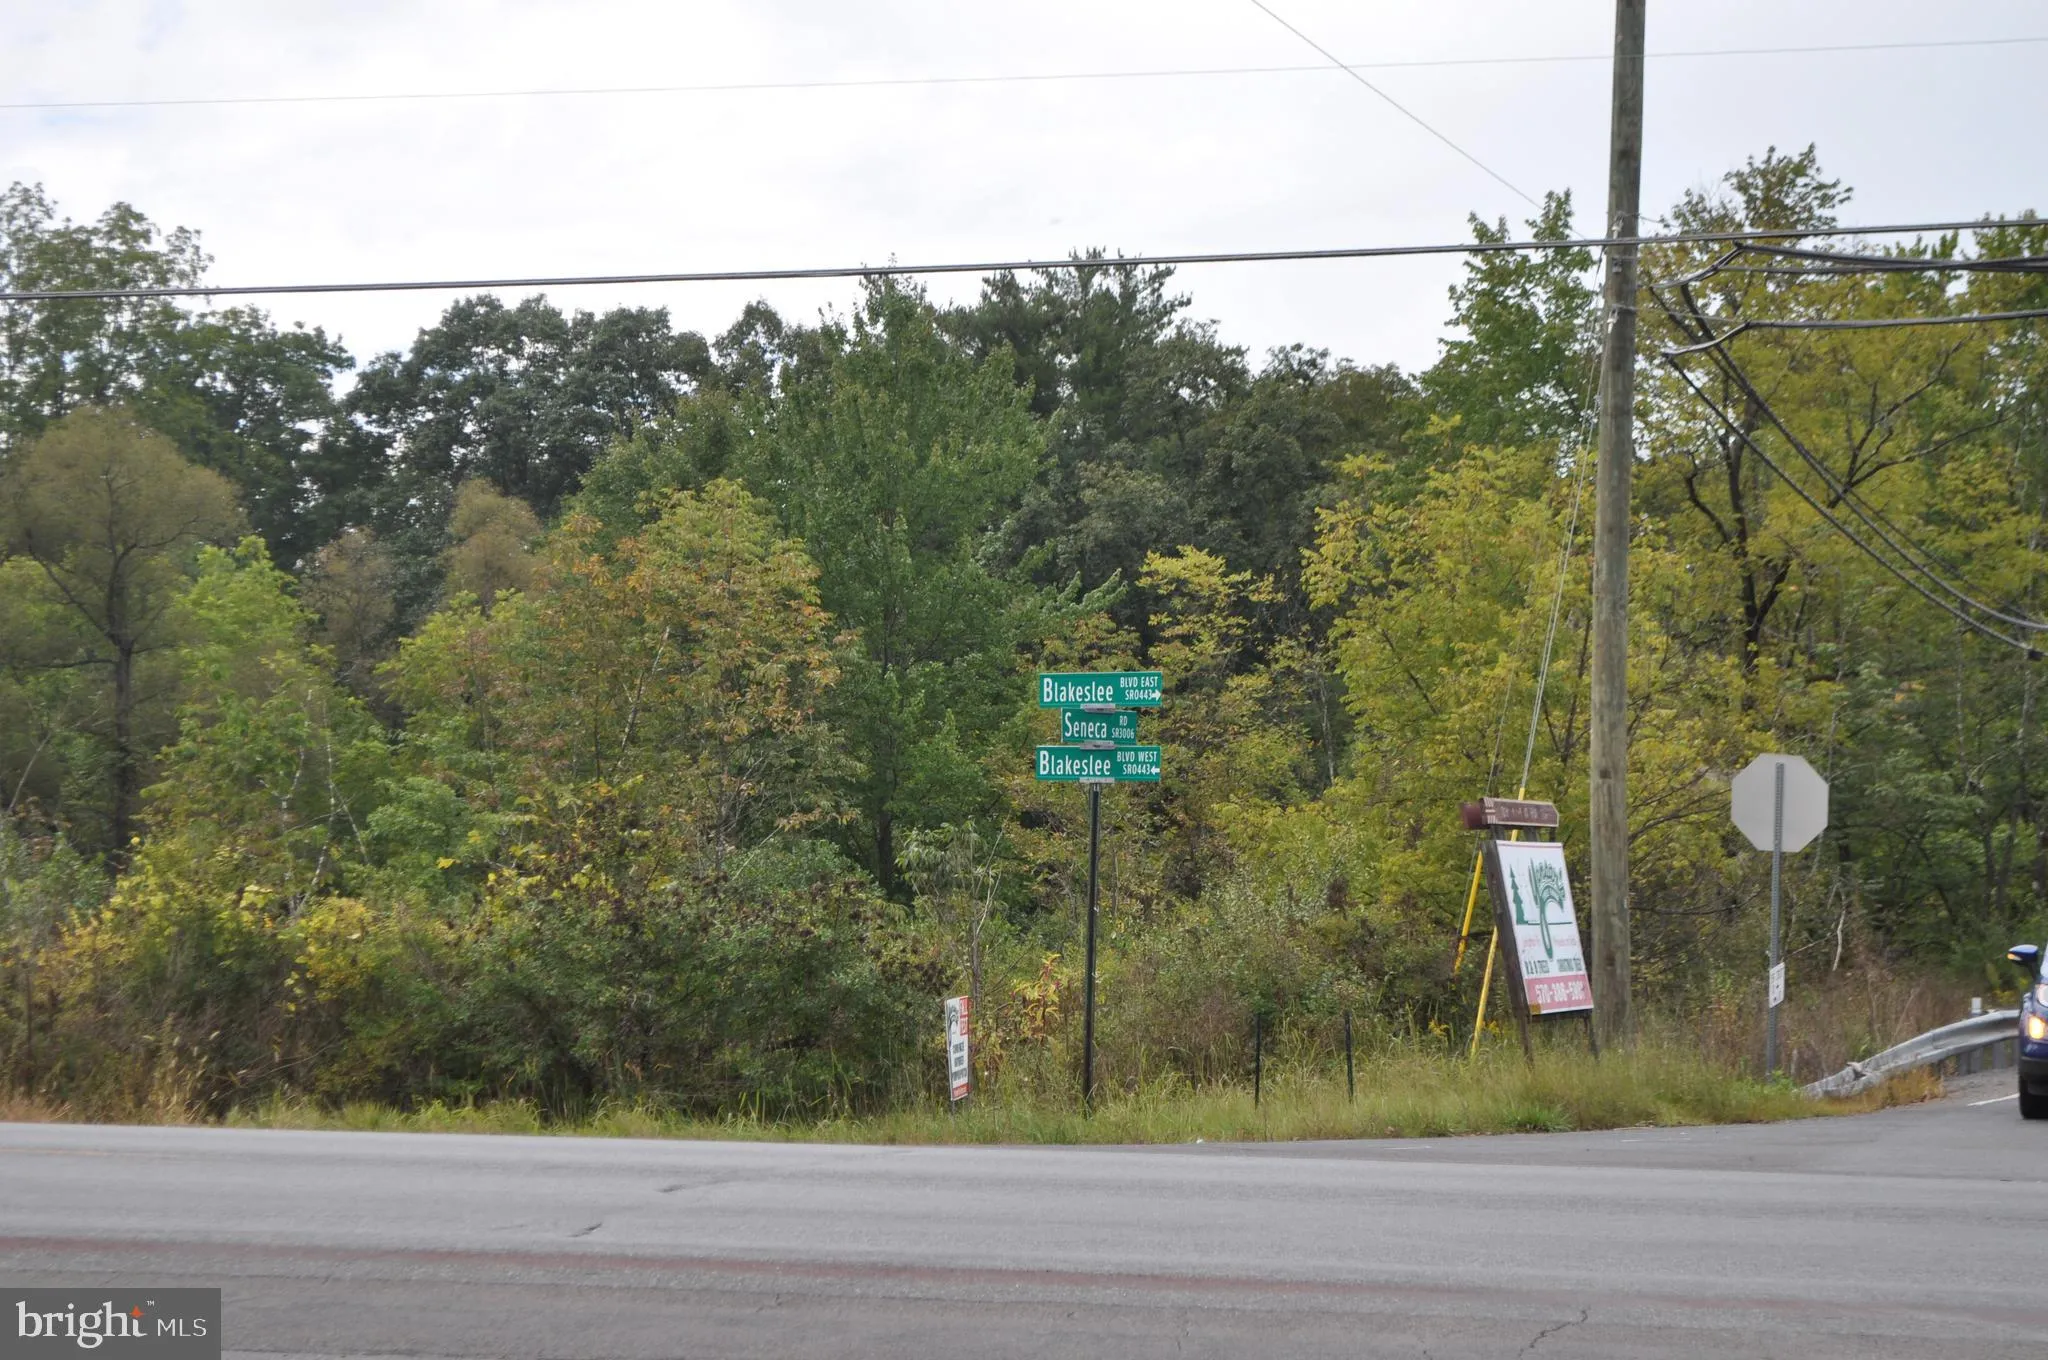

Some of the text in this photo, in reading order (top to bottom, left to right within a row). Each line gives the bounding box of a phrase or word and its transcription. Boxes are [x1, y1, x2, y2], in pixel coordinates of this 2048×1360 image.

[1120, 676, 1158, 688] BLVD EAST
[1043, 677, 1114, 702] Blakeslee
[1124, 689, 1152, 700] SR0443
[1064, 712, 1107, 738] Seneca
[1119, 715, 1128, 726] RD
[1116, 751, 1158, 762] BLVD WEST
[1039, 750, 1111, 775] Blakeslee
[1122, 764, 1151, 775] SR0443
